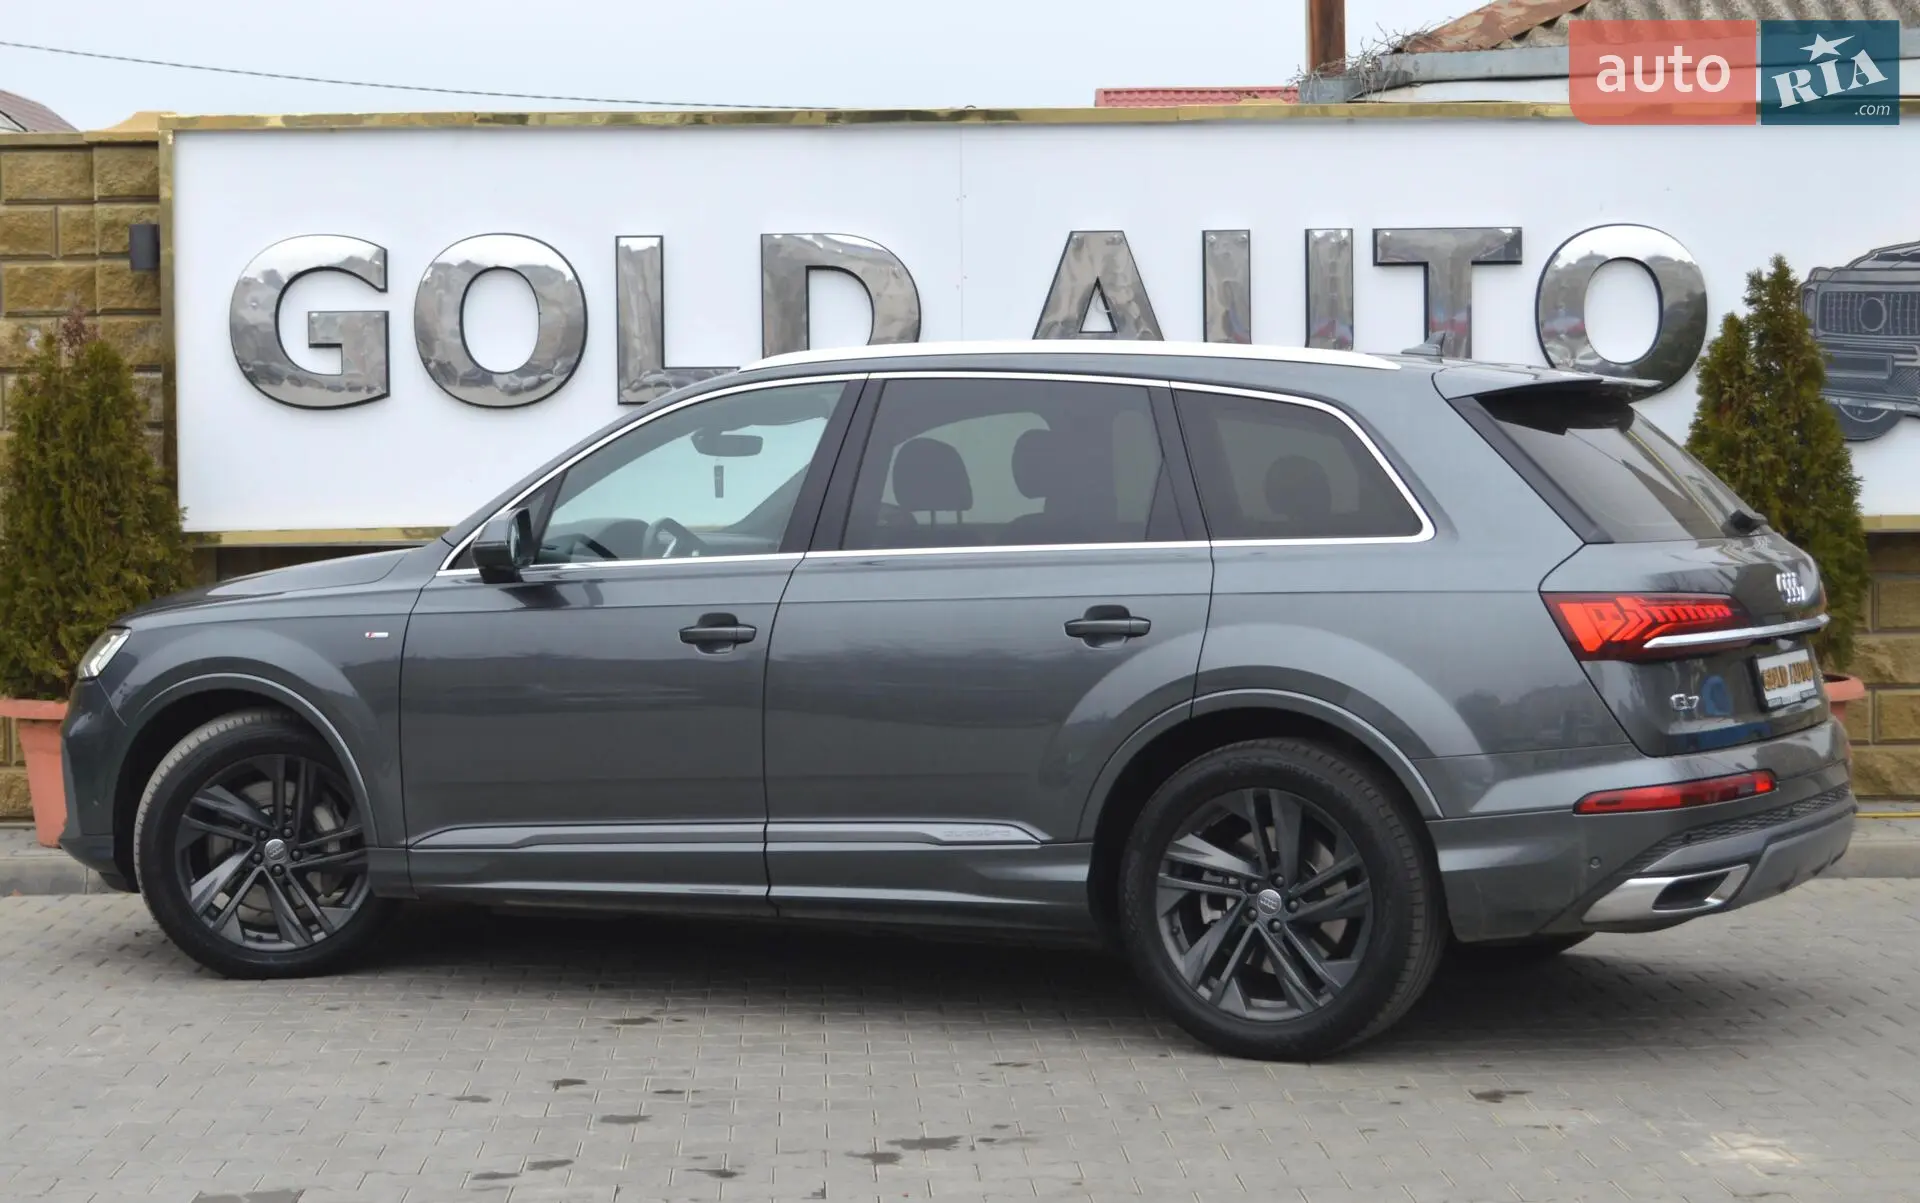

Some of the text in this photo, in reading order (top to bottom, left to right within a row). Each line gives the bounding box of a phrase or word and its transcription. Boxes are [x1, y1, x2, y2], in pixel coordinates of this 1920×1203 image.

[229, 223, 1708, 410] GOLD AUTO
[1764, 666, 1788, 690] GOLD
[1670, 693, 1700, 711] Q7
